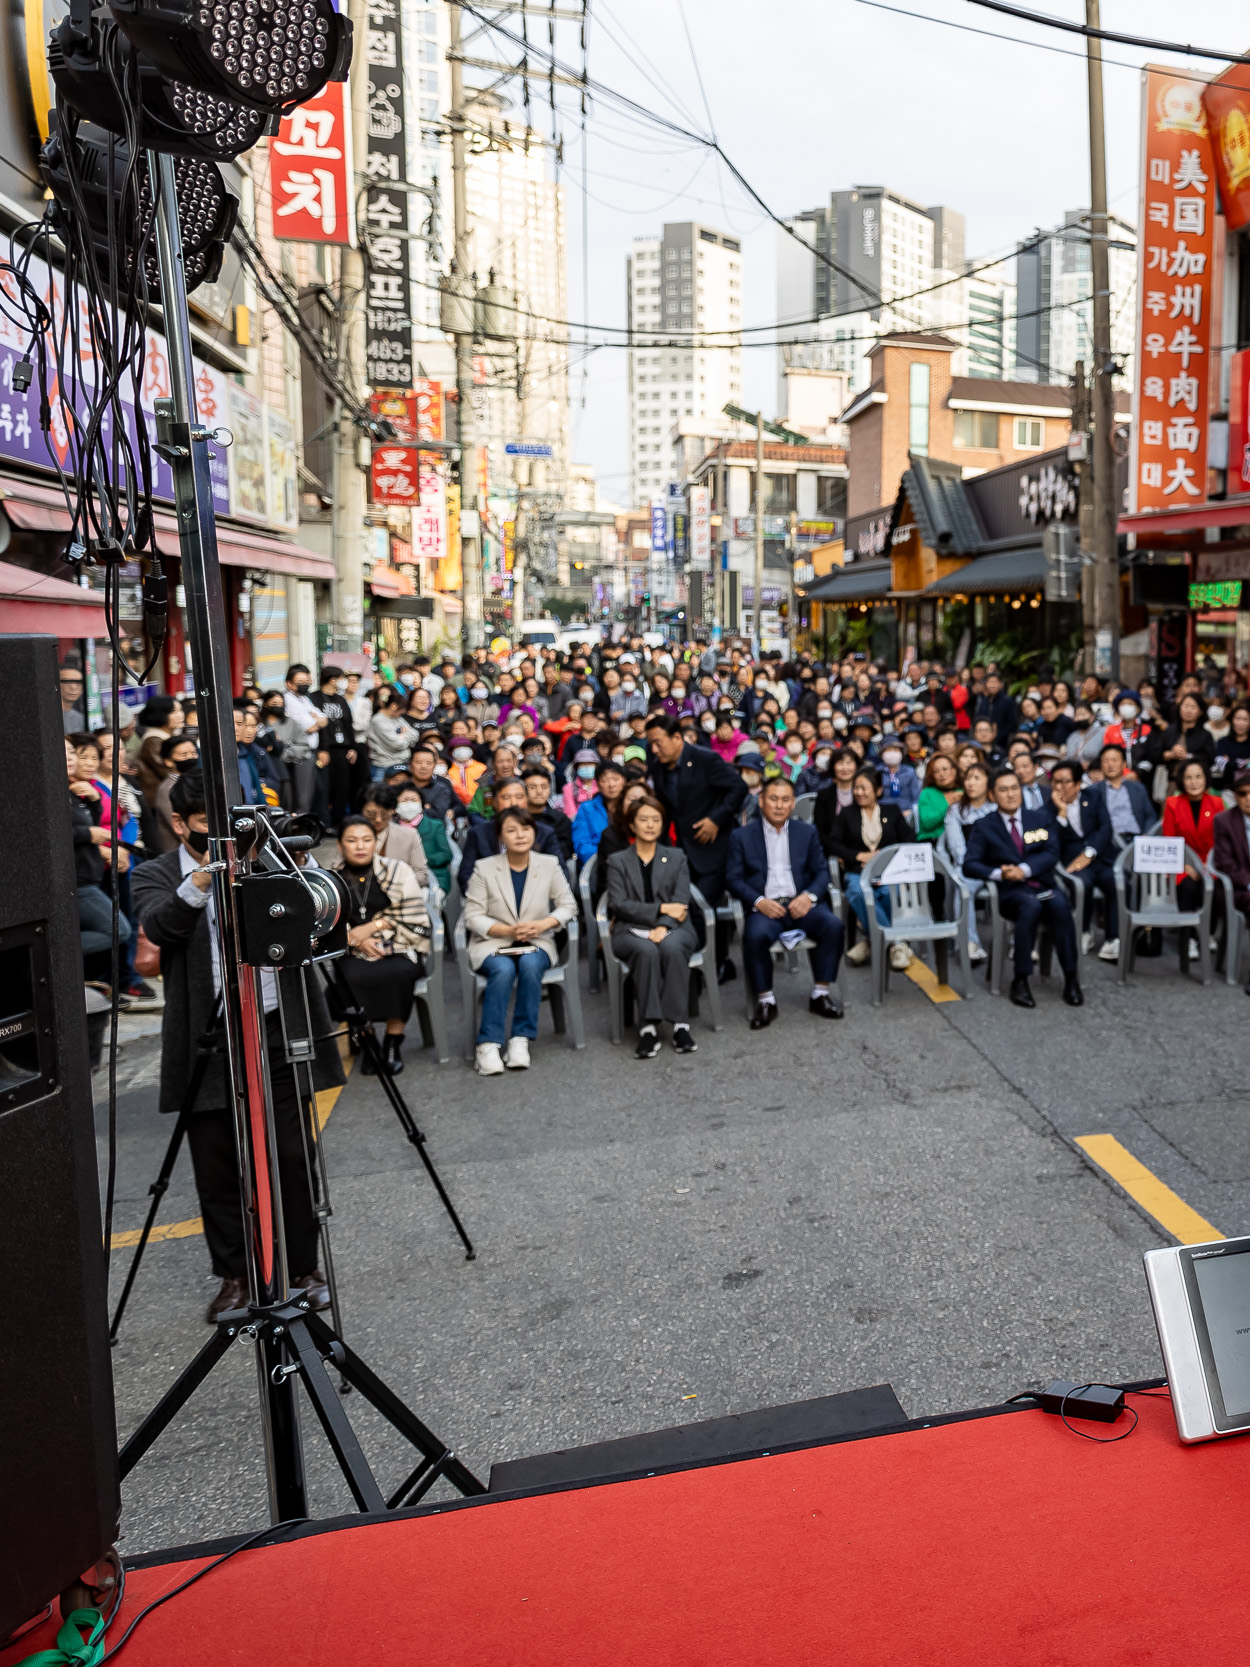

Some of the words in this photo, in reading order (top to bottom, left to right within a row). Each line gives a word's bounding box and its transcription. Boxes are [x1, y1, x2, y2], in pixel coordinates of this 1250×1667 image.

[272, 84, 342, 235] 꼬치
[1141, 158, 1171, 513] 미국가주우육면대
[1163, 149, 1210, 512] 美国加州牛肉面大
